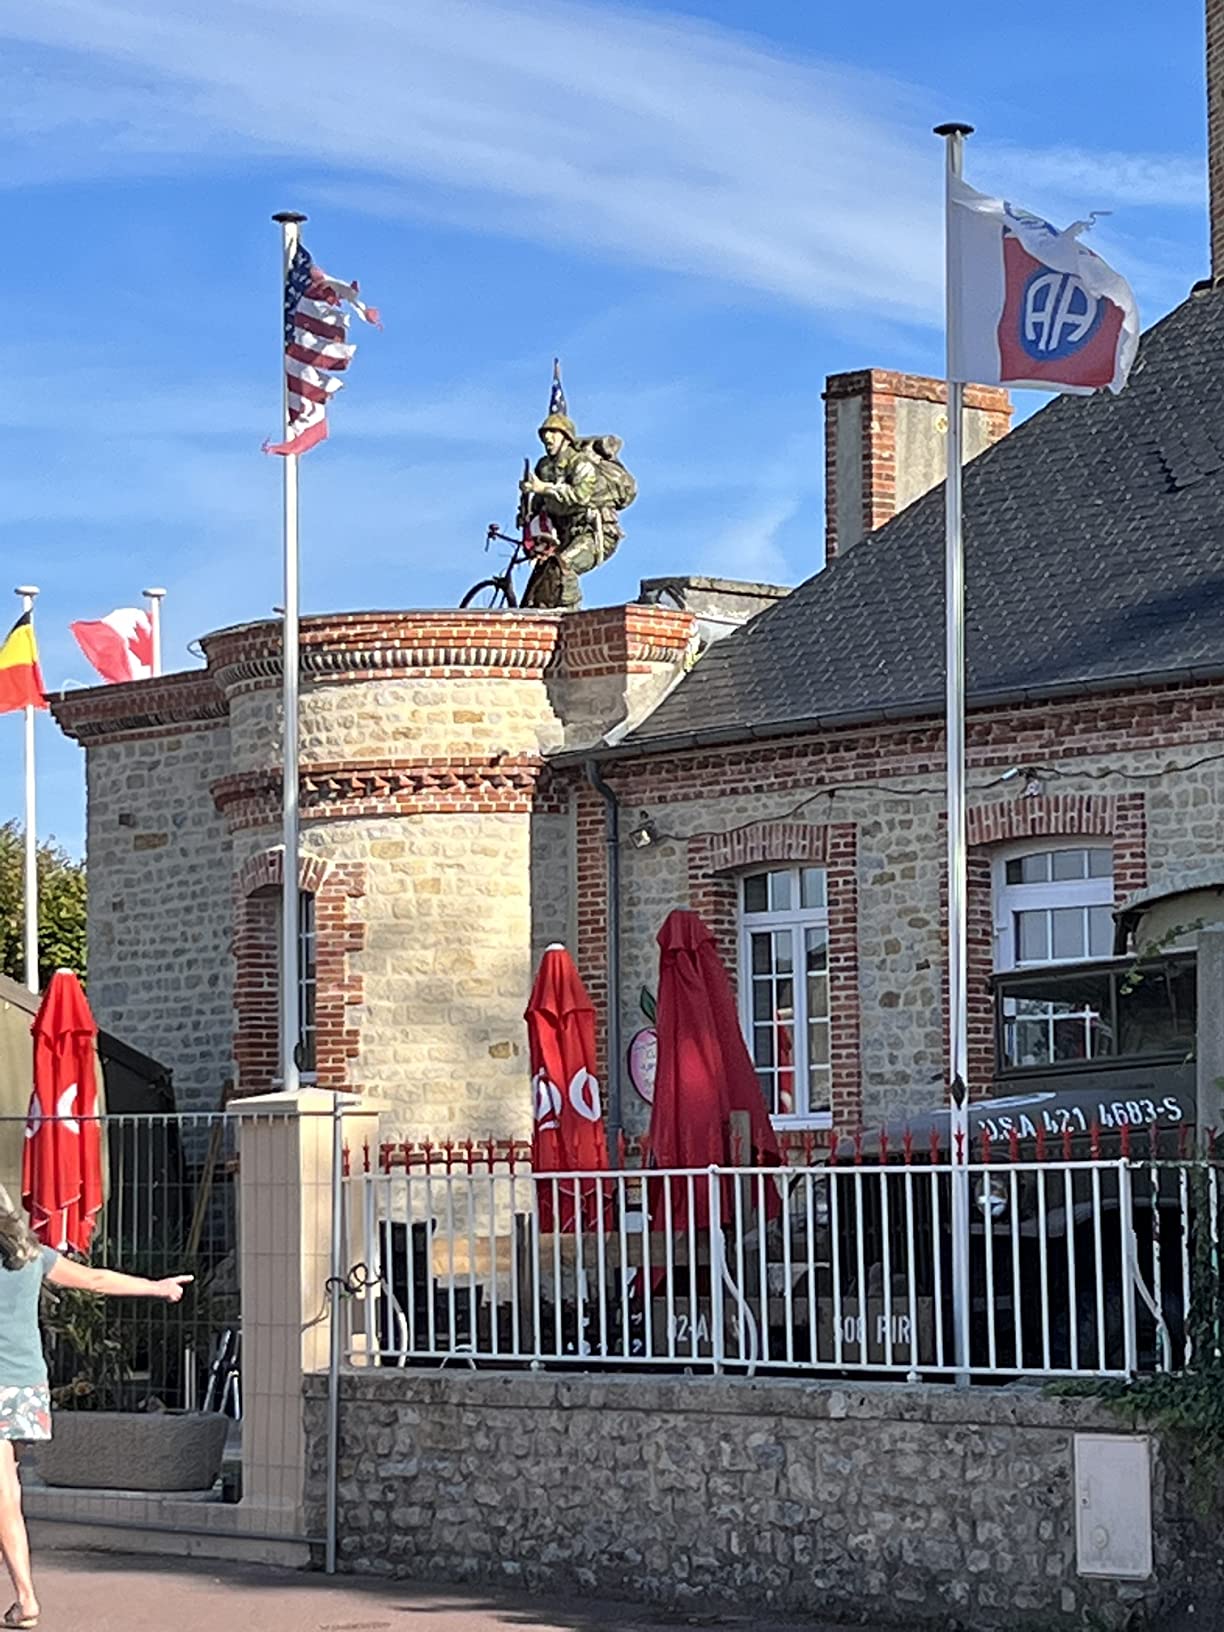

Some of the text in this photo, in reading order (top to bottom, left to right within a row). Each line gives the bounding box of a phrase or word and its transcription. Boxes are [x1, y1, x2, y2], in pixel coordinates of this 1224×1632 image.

[1026, 272, 1098, 350] AA
[1042, 1106, 1086, 1134] 421
[1098, 1096, 1182, 1128] 4683-S
